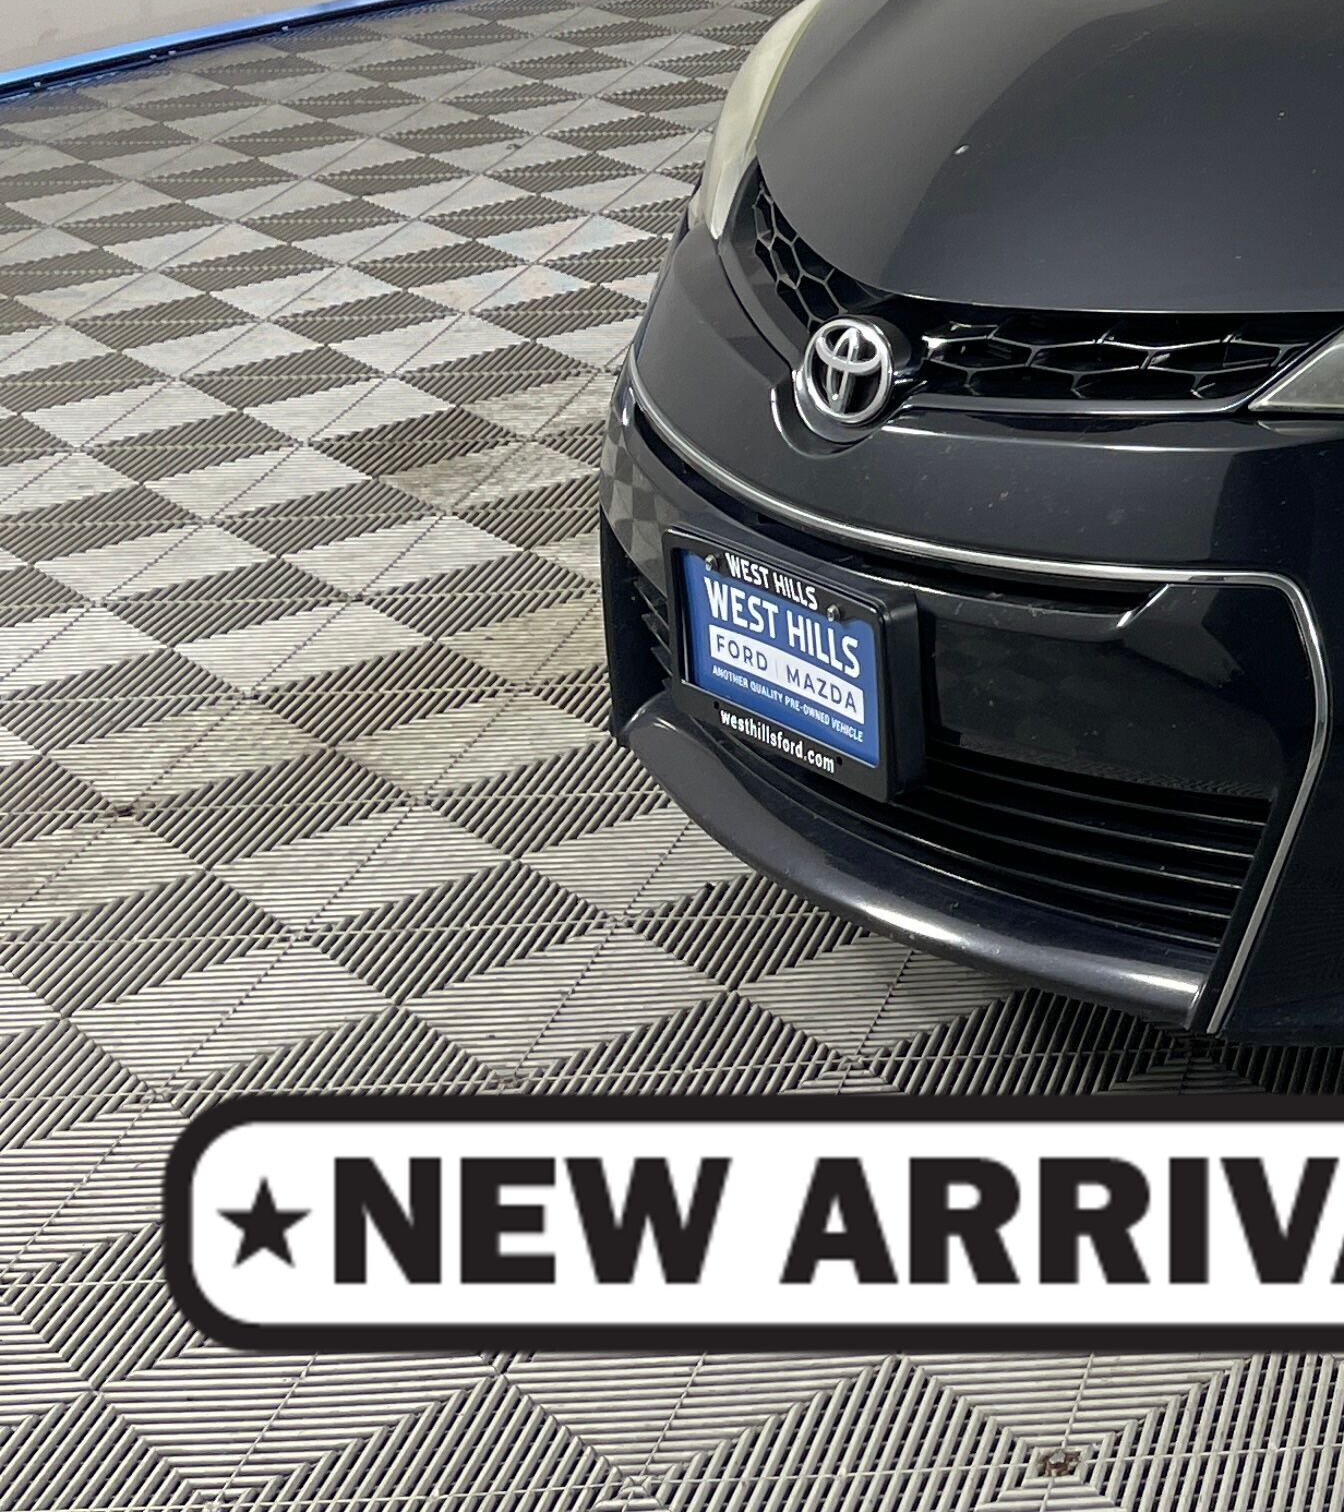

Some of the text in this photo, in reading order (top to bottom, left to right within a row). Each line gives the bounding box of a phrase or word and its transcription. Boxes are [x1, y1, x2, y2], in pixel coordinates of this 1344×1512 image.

[725, 552, 819, 611] WEST HILLS
[704, 576, 861, 679] WEST HILLS
[712, 665, 864, 743] ANOTHER QUALITY PRE-OWNED VEHICLE
[716, 634, 857, 714] FORD MAZDA
[720, 709, 835, 774] westhillsford.com
